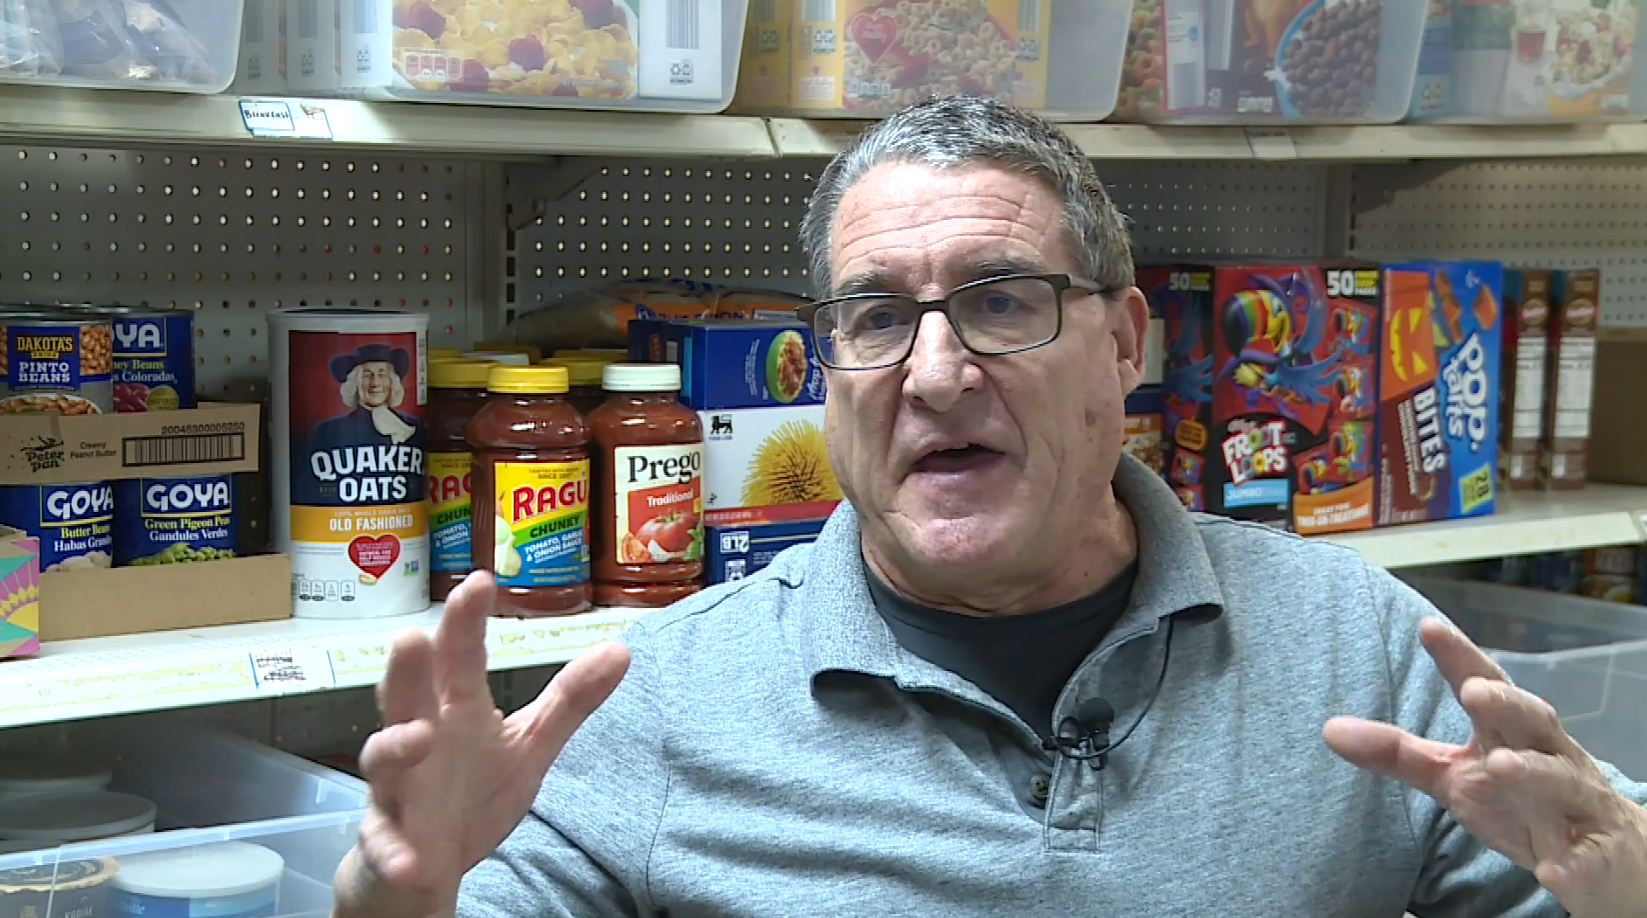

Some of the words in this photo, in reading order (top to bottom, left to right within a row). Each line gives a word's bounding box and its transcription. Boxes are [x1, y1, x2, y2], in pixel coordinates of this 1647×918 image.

[1169, 272, 1190, 291] 50
[1327, 270, 1354, 296] 50
[17, 336, 73, 352] DAKOTA'S
[112, 324, 160, 349] YA
[19, 361, 69, 373] PINTO
[133, 359, 164, 369] Beans
[18, 373, 71, 383] BEANS
[1413, 387, 1447, 474] BITES
[1222, 422, 1285, 464] FROOT
[70, 450, 94, 459] Peanut
[96, 449, 117, 457] Butter
[311, 445, 423, 481] QUAKER
[627, 450, 701, 485] Prego
[1229, 448, 1287, 485] LOOPS
[146, 481, 230, 512] GOYA
[339, 475, 407, 502] OATS
[646, 488, 694, 507] Traditional
[47, 485, 114, 520] GOYA
[144, 518, 177, 530] Green
[181, 517, 213, 530] Pigeon
[329, 518, 352, 532] OLD
[356, 514, 413, 531] FASHIONED
[437, 506, 472, 525] CHUN
[61, 527, 91, 539] Butter
[149, 530, 200, 541] Gandules
[201, 528, 228, 539] Verdes
[529, 514, 581, 539] CHUNKY
[54, 539, 87, 552] Habas
[534, 546, 561, 559] ONION
